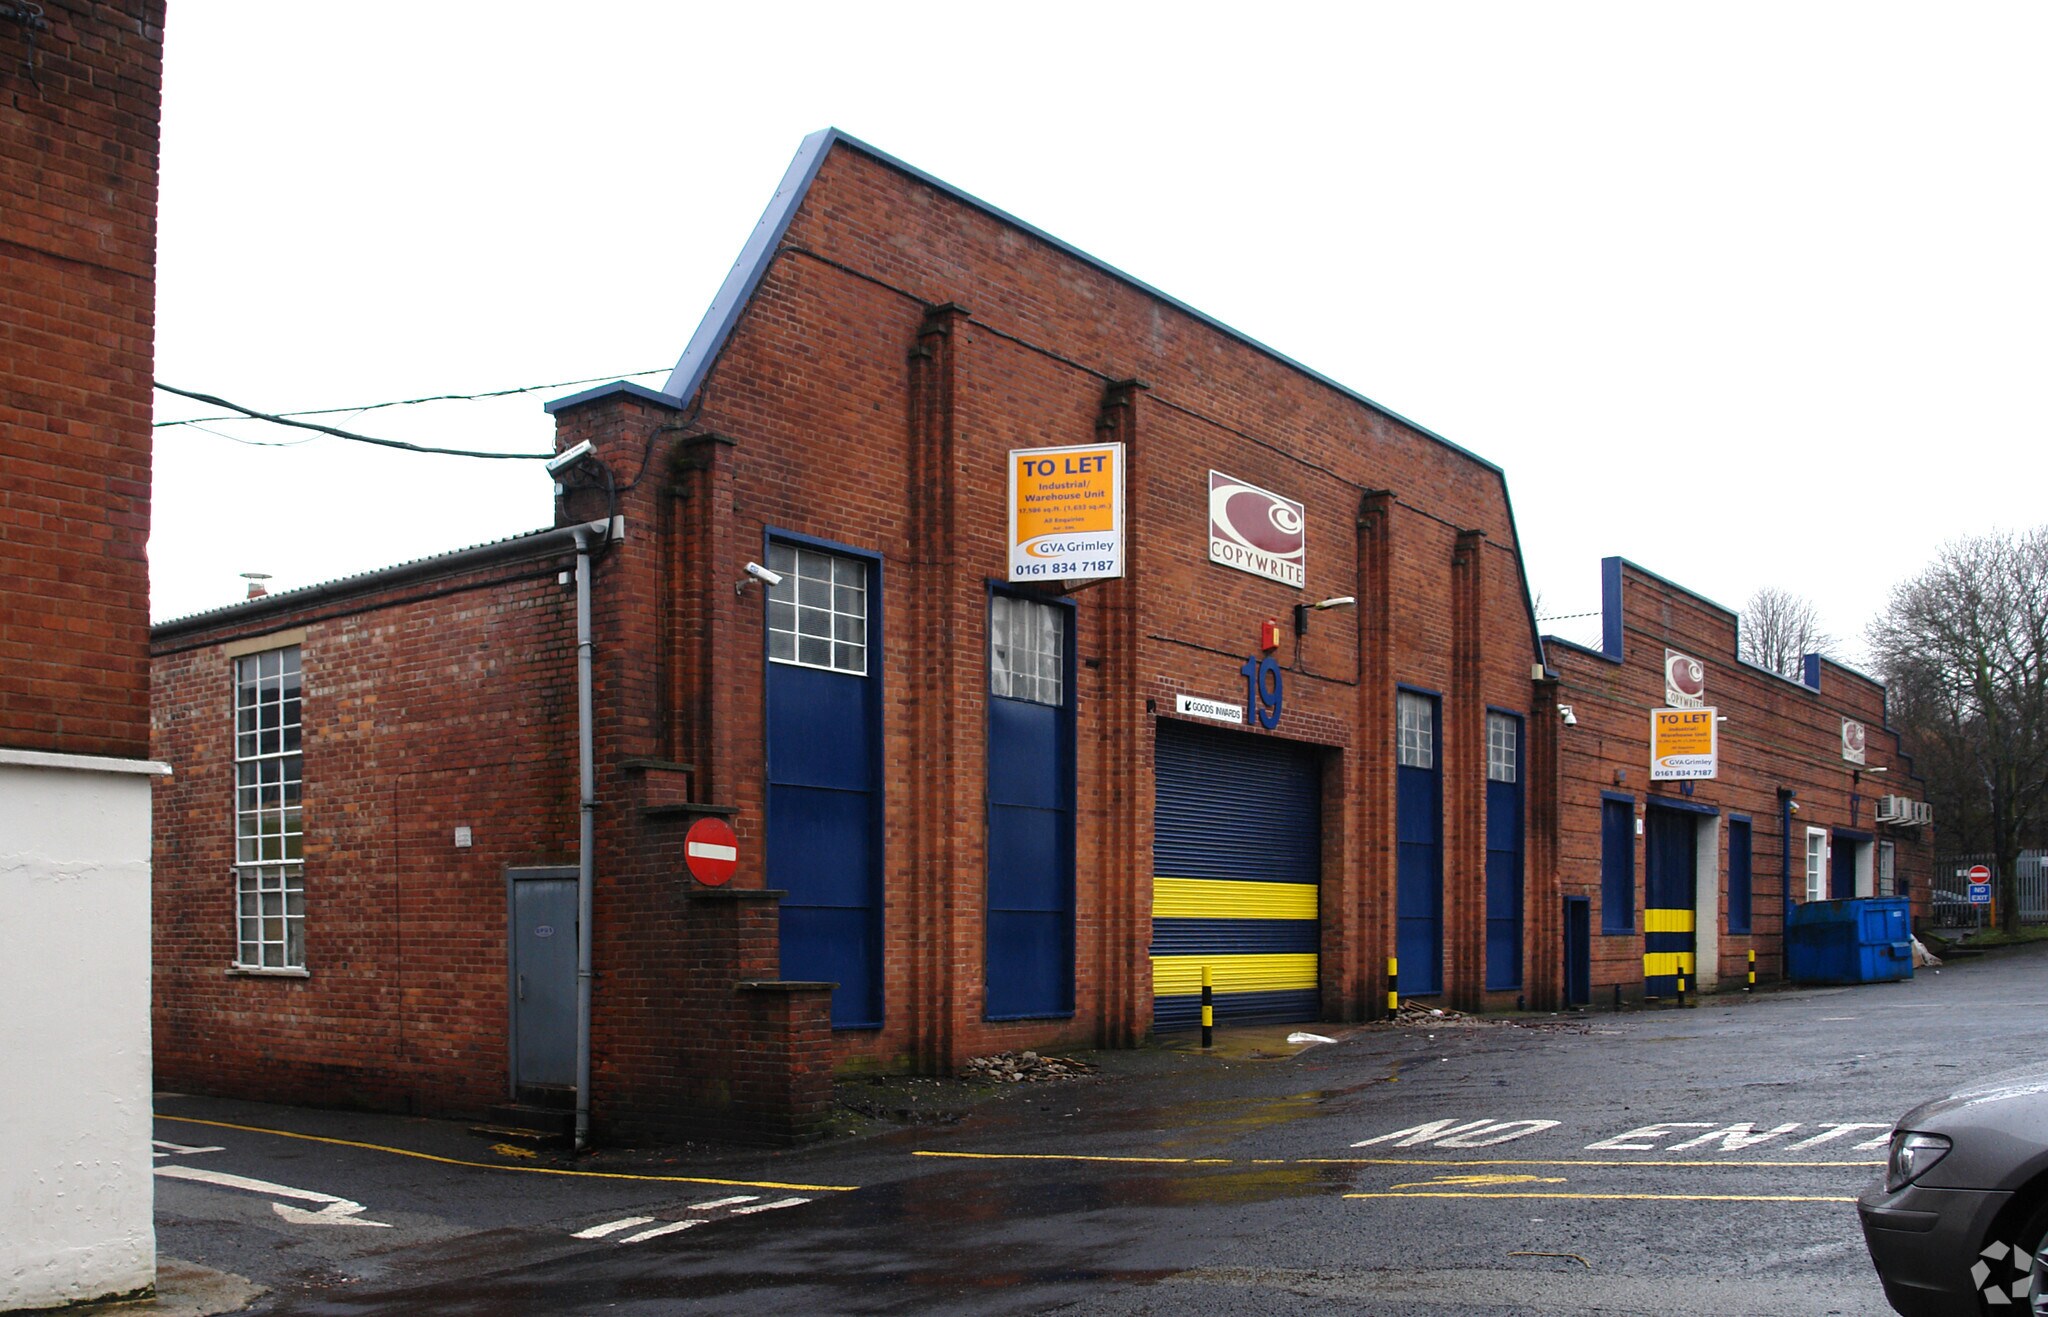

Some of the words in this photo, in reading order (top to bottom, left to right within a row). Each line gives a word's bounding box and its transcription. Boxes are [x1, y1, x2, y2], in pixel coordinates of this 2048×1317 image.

[1023, 459, 1056, 477] TO
[1065, 456, 1106, 474] LET
[1039, 480, 1091, 491] Industrial/
[1025, 493, 1081, 502] Warehouse
[1084, 490, 1105, 498] Unit
[1040, 543, 1065, 553] GVA
[1067, 541, 1114, 552] Grimley
[1016, 564, 1046, 575] 0161
[1052, 562, 1077, 574] 834
[1082, 561, 1114, 572] 7187
[1212, 541, 1303, 583] COPYWRITE
[1240, 655, 1283, 730] 19
[1192, 701, 1214, 715] GOODS
[1215, 706, 1241, 720] INWARDS
[1660, 715, 1679, 724] TO
[1684, 714, 1708, 723] LET
[1350, 1118, 1561, 1148] NO
[1584, 1122, 1892, 1150] ENT
